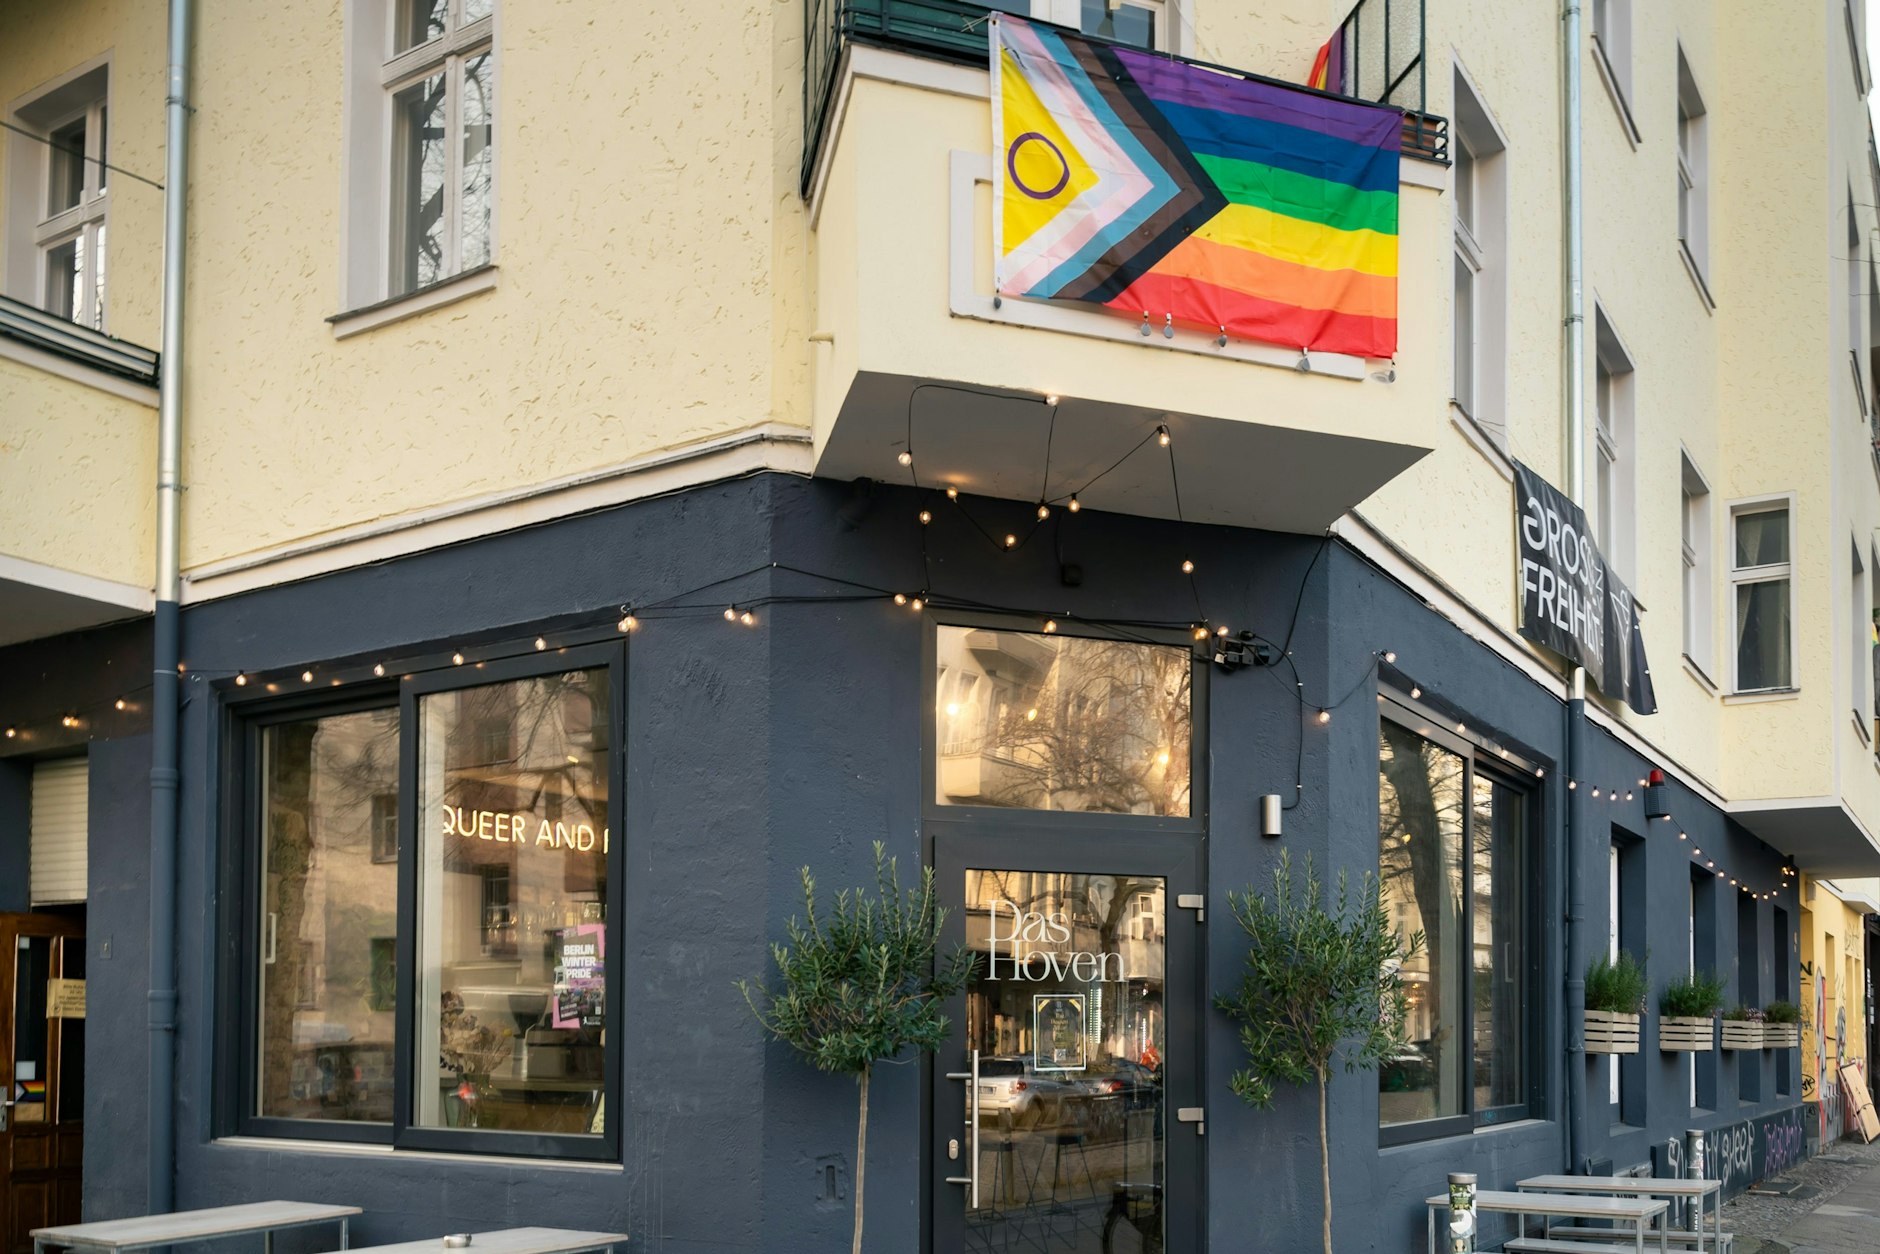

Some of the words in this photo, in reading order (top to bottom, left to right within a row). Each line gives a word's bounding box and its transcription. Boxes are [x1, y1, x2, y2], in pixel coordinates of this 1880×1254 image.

[443, 804, 526, 844] QUEER
[535, 819, 595, 852] AND
[984, 899, 1071, 943] Das
[561, 956, 596, 967] WINTER
[563, 944, 594, 956] BERLIN
[984, 938, 1129, 983] Hoven
[566, 967, 592, 979] PRIDE
